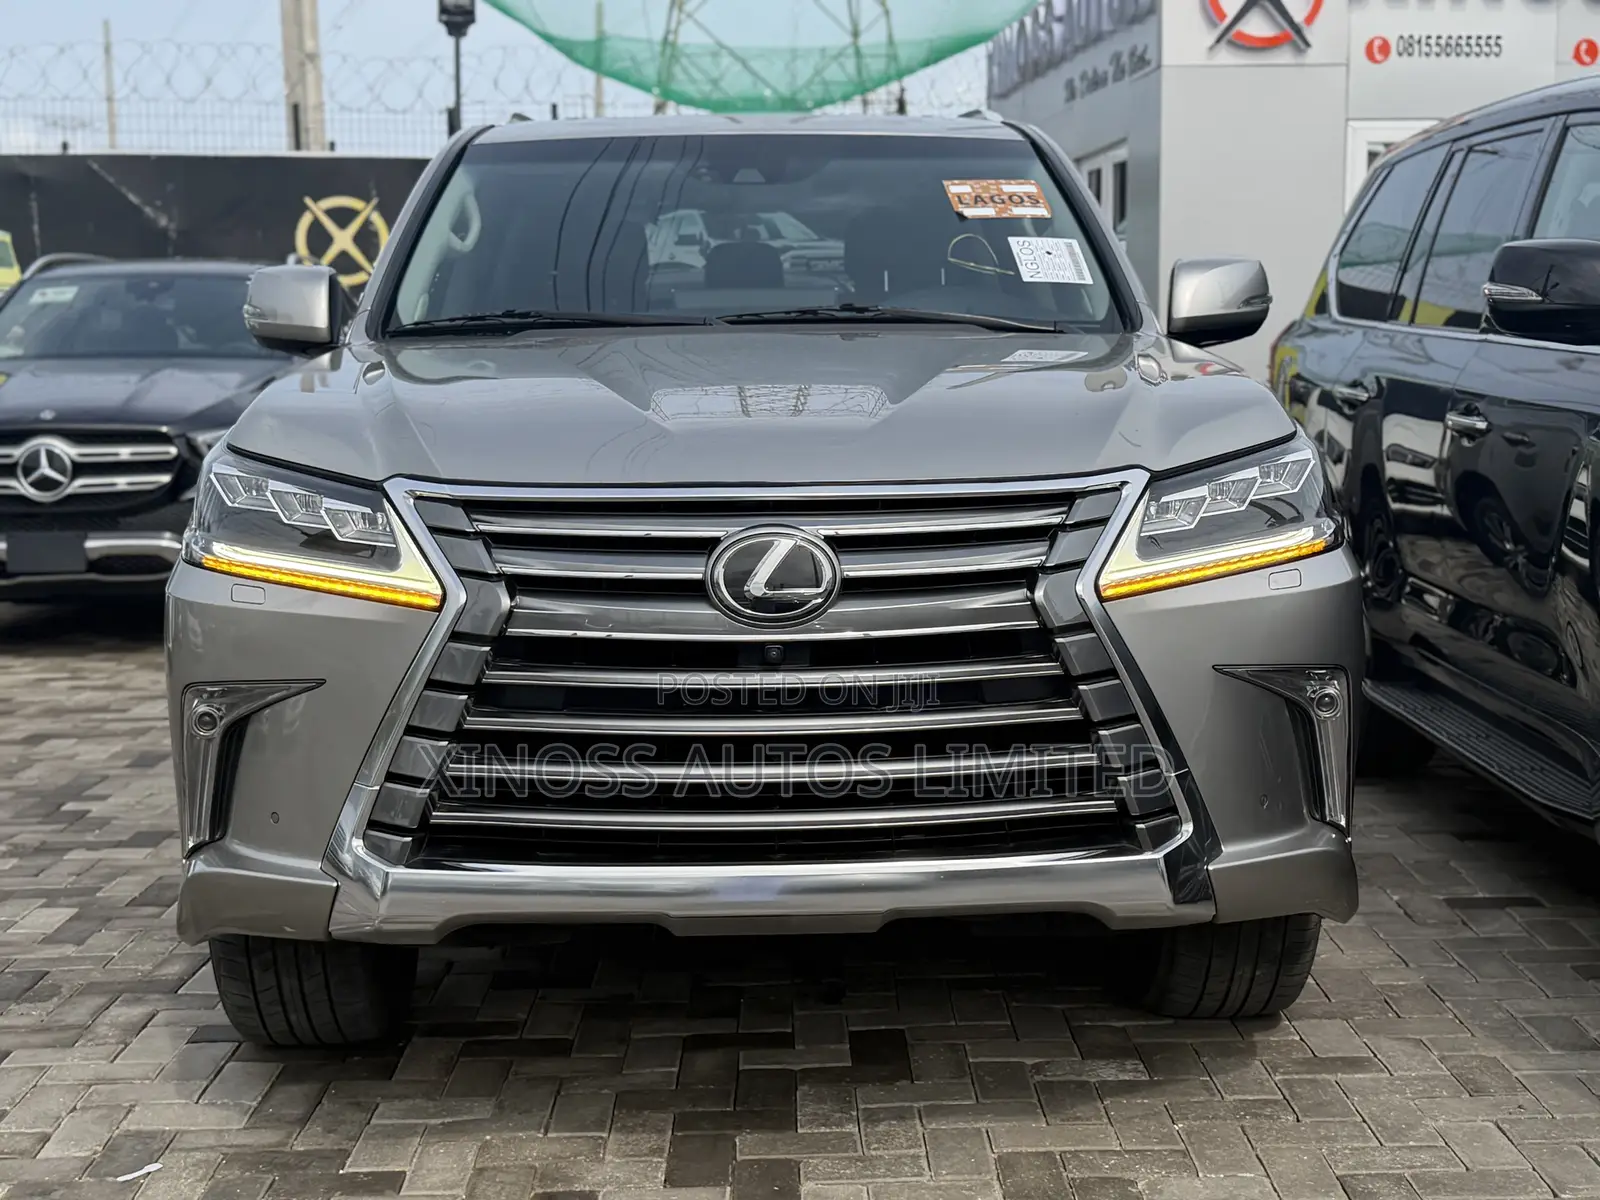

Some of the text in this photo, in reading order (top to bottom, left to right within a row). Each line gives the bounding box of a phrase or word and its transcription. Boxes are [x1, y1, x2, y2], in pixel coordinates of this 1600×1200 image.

[1396, 34, 1503, 58] 08155665555
[955, 193, 1041, 206] LAGOS
[1016, 239, 1043, 280] NGLOS
